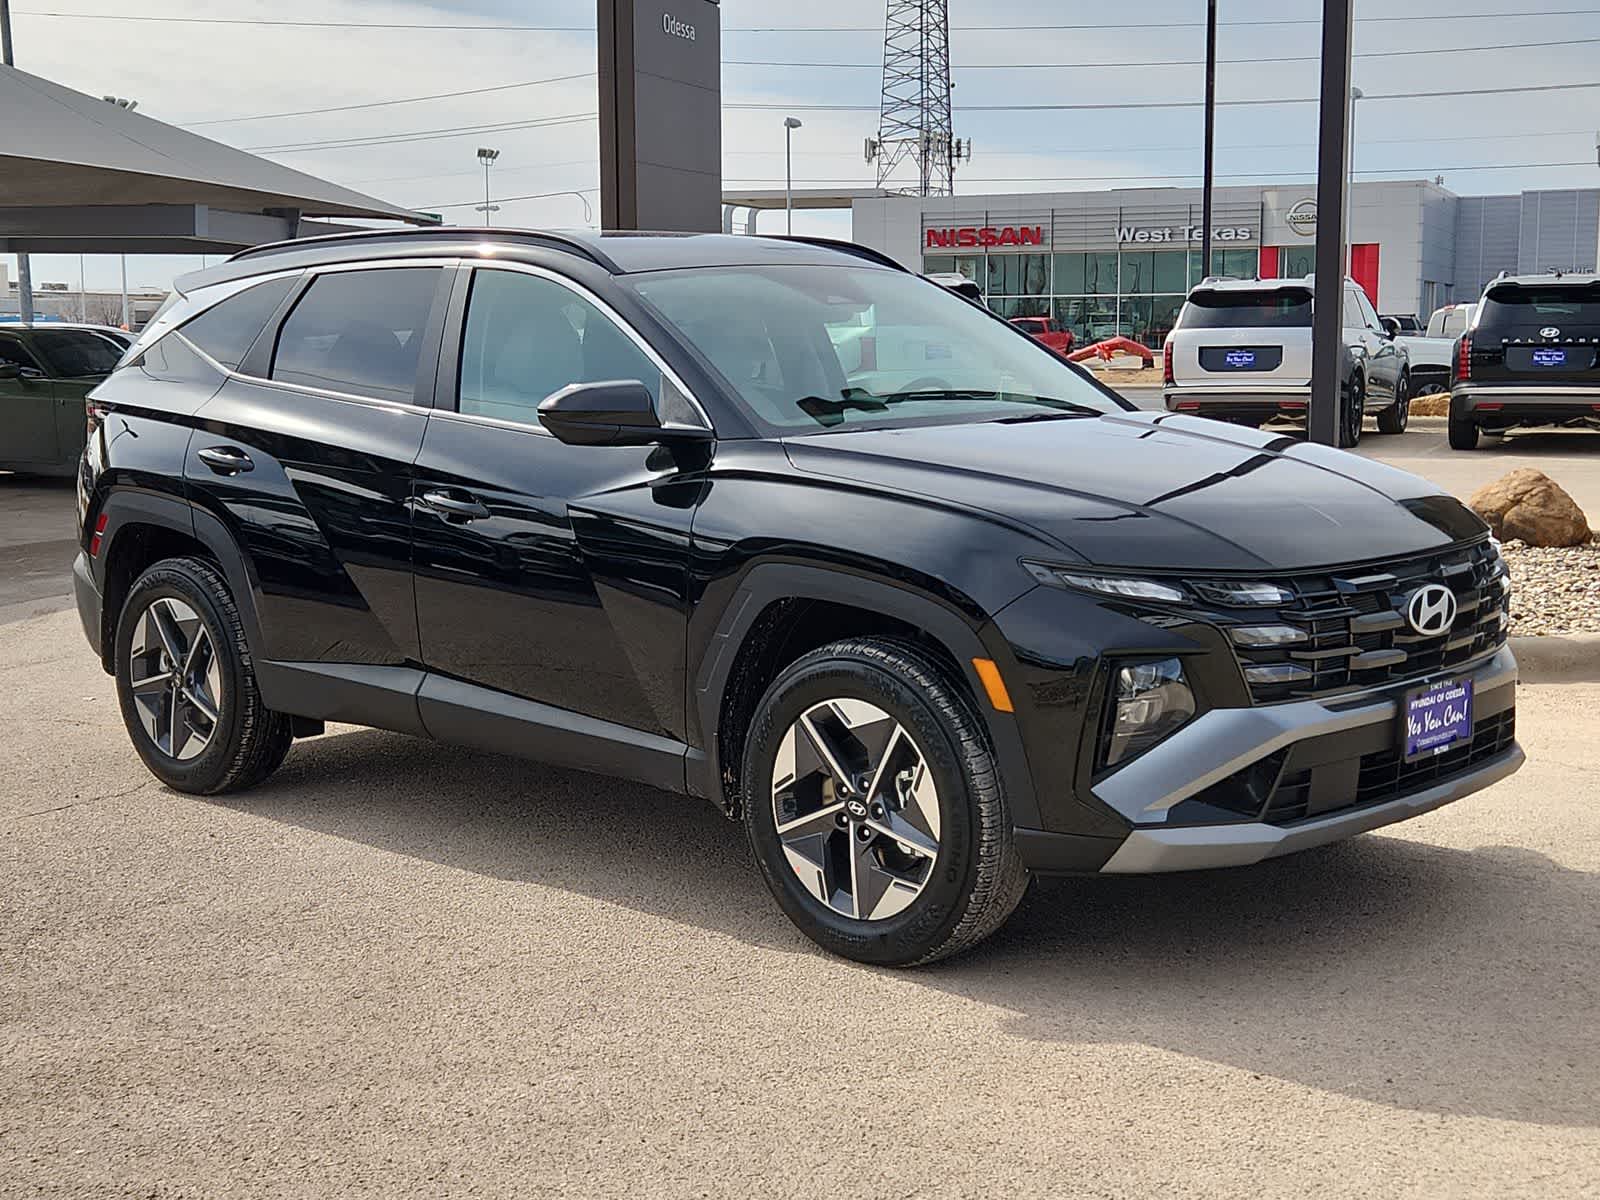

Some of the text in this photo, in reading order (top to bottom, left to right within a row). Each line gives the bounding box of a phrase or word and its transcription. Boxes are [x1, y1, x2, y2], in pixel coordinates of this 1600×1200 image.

[663, 13, 695, 41] Odessa
[926, 226, 1041, 248] NISSAN
[1115, 226, 1171, 242] West
[1408, 715, 1421, 738] Yes
[1424, 710, 1442, 733] You
[1444, 699, 1468, 726] Can!
